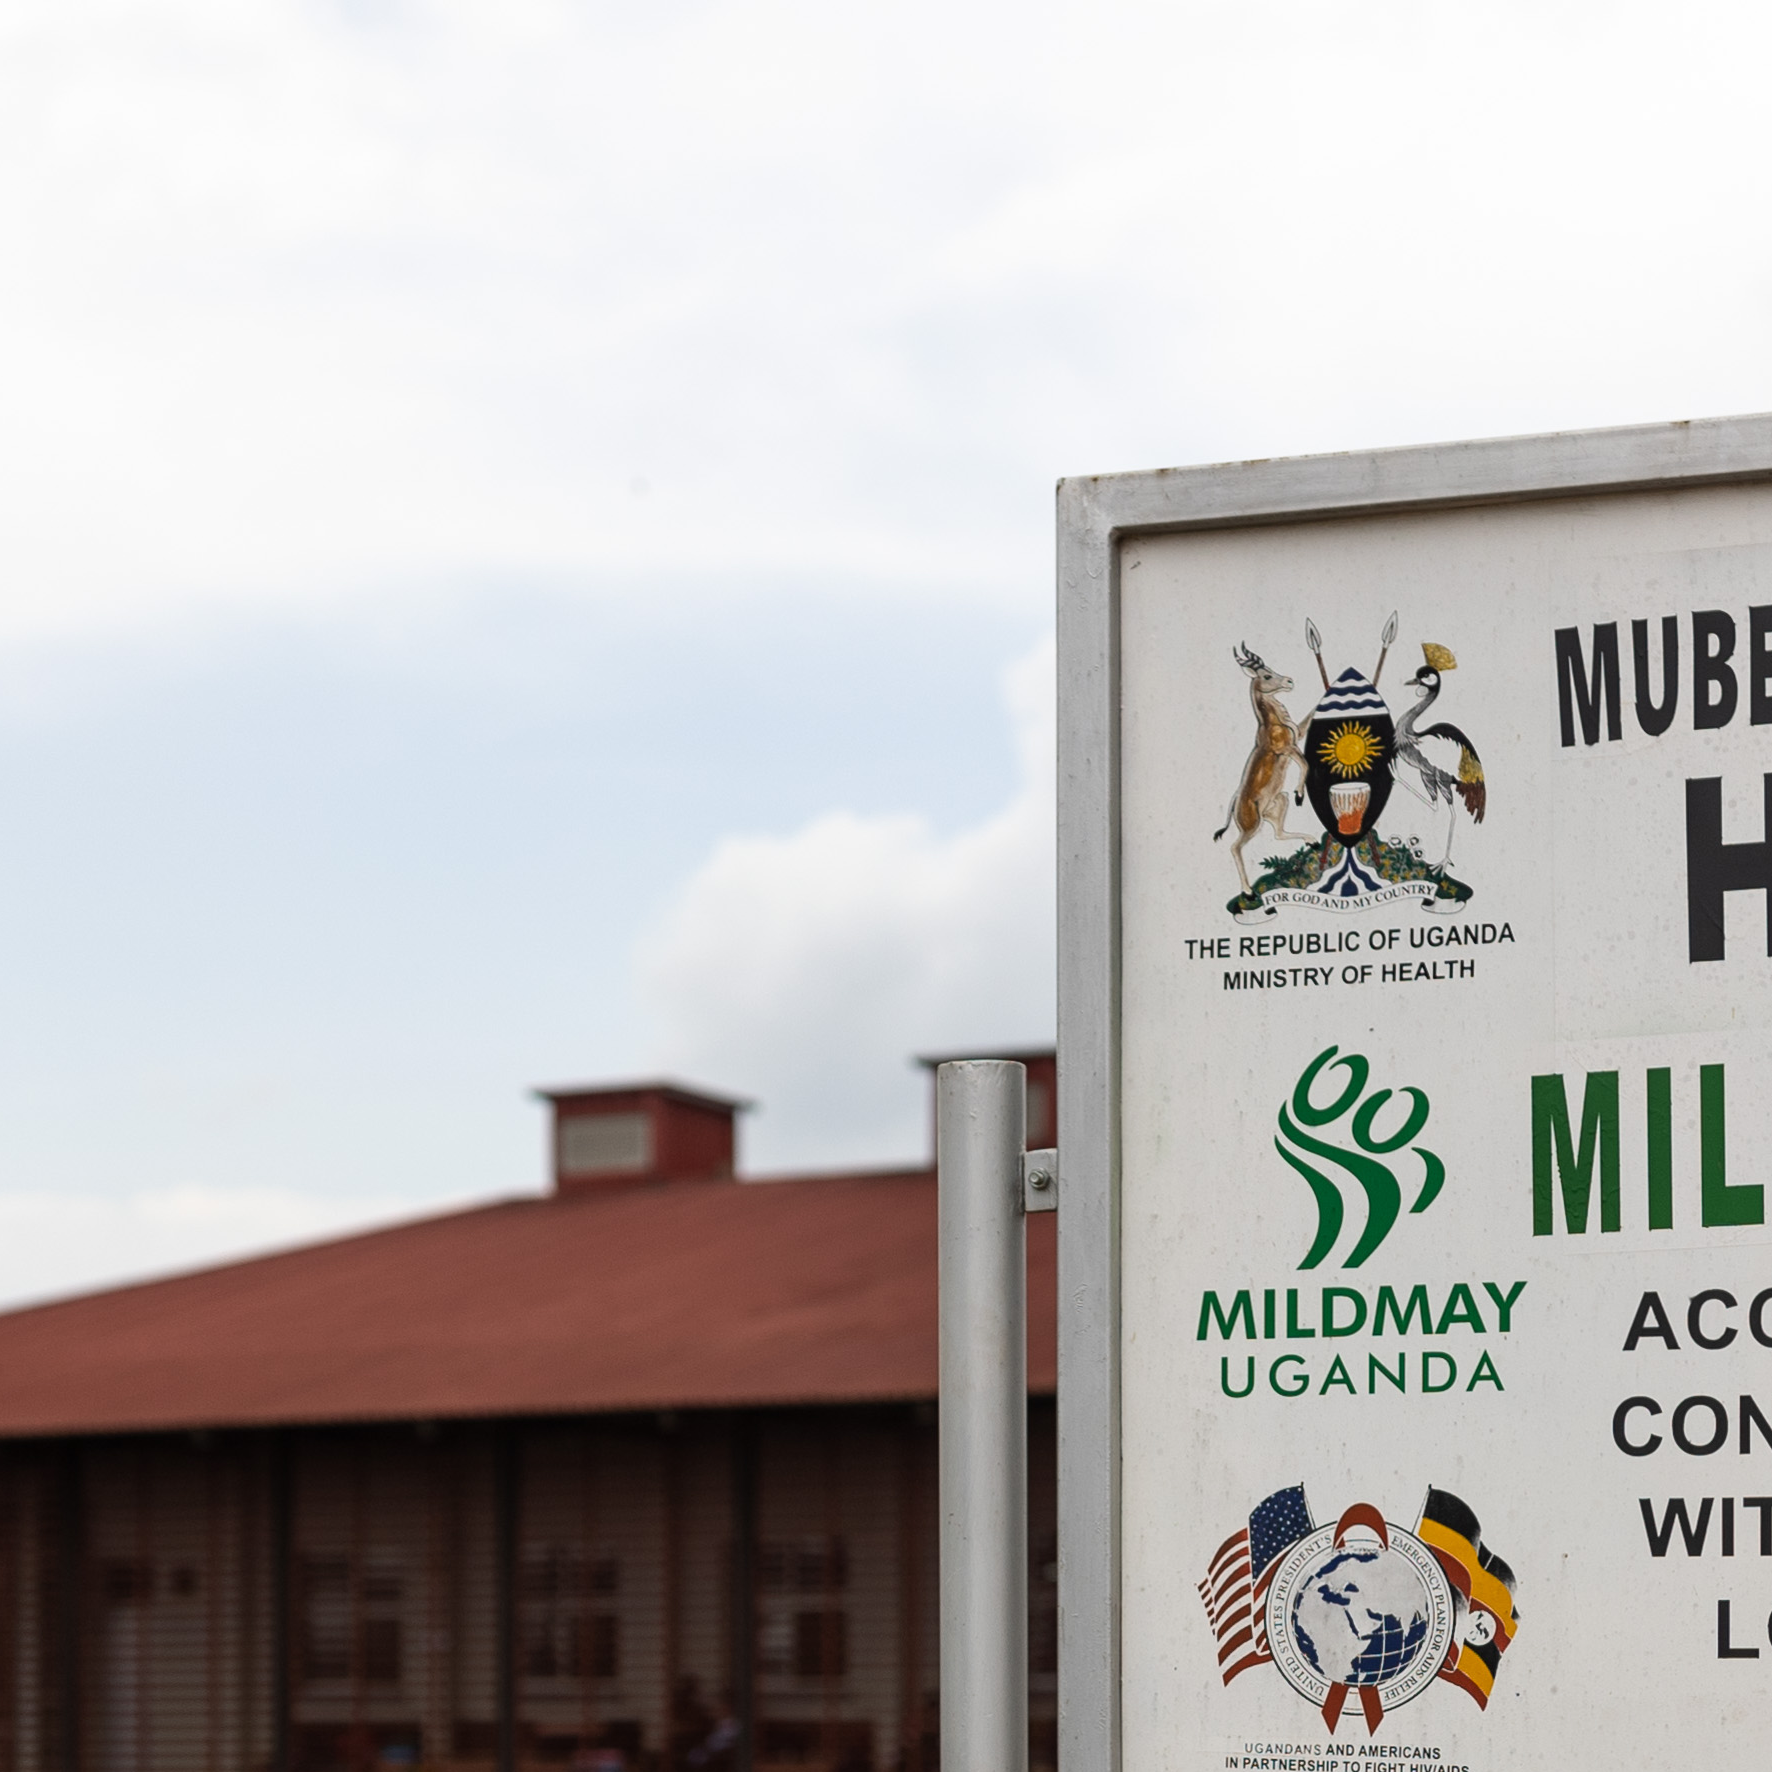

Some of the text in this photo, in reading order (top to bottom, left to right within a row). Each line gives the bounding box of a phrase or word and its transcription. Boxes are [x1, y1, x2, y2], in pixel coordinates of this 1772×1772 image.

[1265, 884, 1435, 910] FOR GOD AND MY COUNTRY
[1185, 923, 1515, 959] THE REPUBLIC OF UGANDA
[1224, 959, 1474, 990] MINISTRY OF HEALTH
[1197, 1281, 1527, 1340] MILDMAY
[1222, 1350, 1504, 1398] UGANDA
[1274, 1535, 1332, 1697] UNITED STATES PRESIDENT'S
[1384, 1535, 1446, 1701] EMERGENCY PLAN FOR AIDS RELIEF
[1226, 1757, 1238, 1768] IN
[1243, 1758, 1338, 1772] PARTNERSHIP
[1343, 1761, 1360, 1772] TO
[1244, 1743, 1440, 1759] UGANDANS AND AMERICANS
